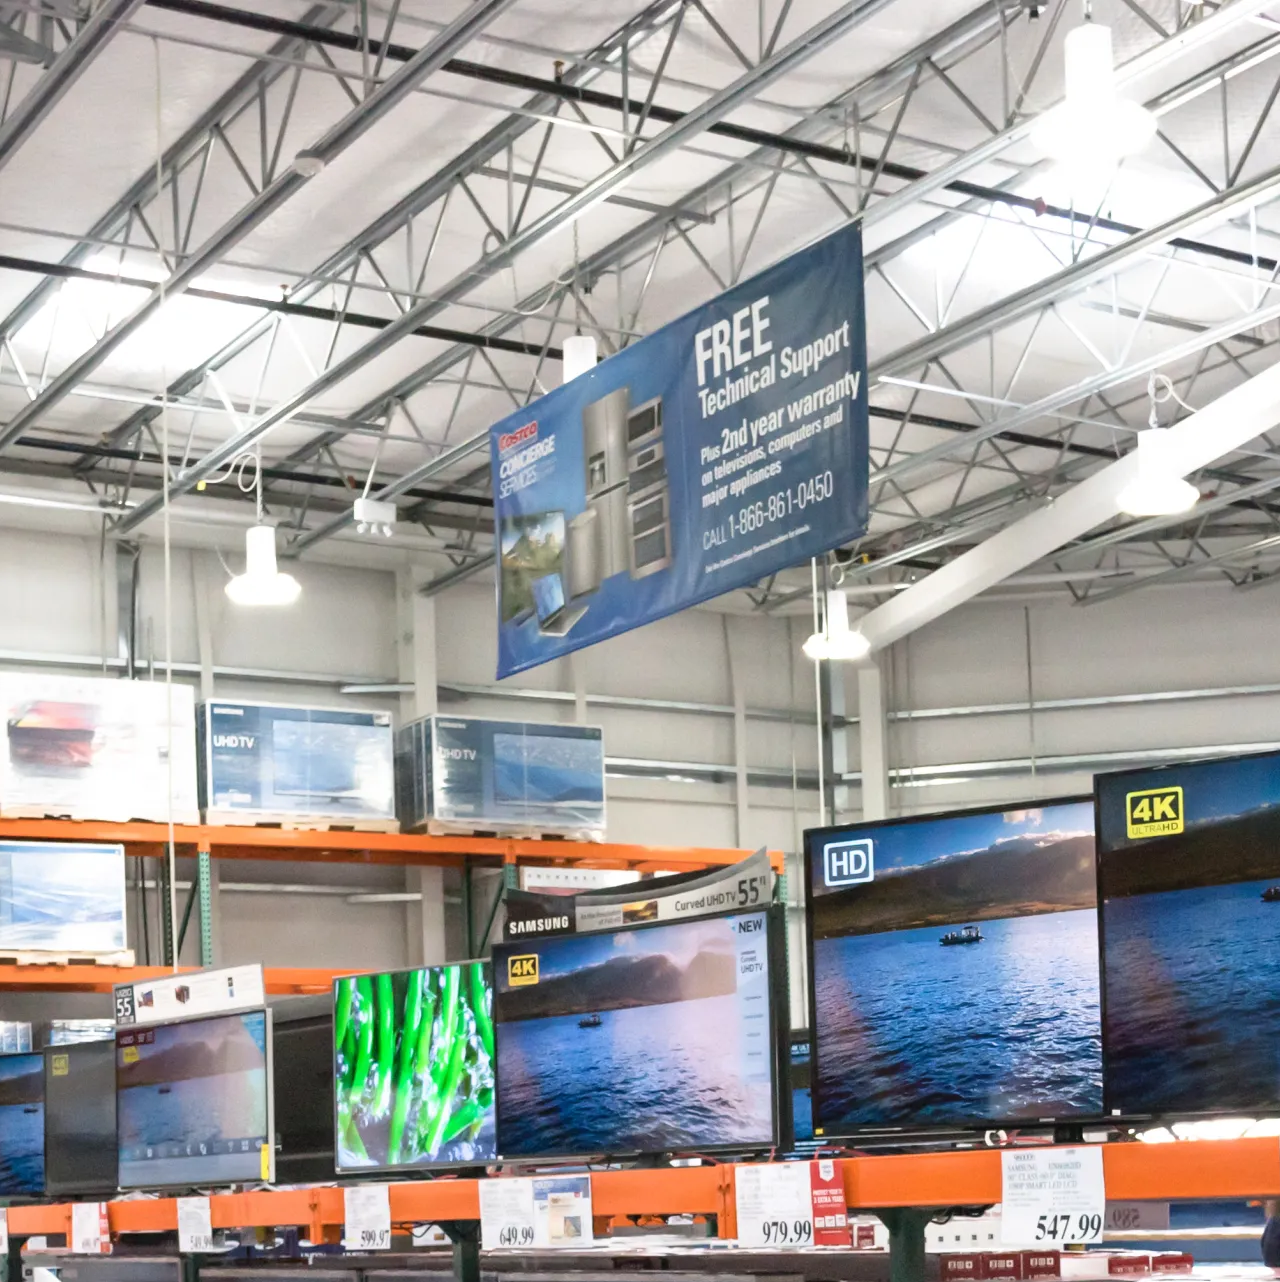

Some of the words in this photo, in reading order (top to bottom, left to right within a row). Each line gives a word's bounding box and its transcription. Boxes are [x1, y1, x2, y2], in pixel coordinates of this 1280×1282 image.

[695, 295, 773, 386] FREE
[698, 353, 776, 419] Technical
[780, 319, 850, 379] Support
[701, 444, 720, 465] Plus
[721, 418, 748, 454] 2nd
[750, 407, 785, 447] year
[787, 371, 861, 422] warranty
[702, 471, 713, 486] on
[714, 447, 767, 480] televisions,
[768, 418, 821, 454] computers
[823, 404, 843, 430] and
[702, 484, 729, 508] major
[730, 460, 782, 496] appliances
[703, 521, 728, 550] CALL
[728, 470, 833, 539] 1-866-861-0450
[1132, 794, 1177, 822] 4K
[831, 851, 867, 877] HD
[674, 898, 706, 913] Curved
[509, 915, 569, 935] SAMSUNG
[738, 918, 763, 935] NEW
[511, 959, 535, 978] 4K
[116, 998, 132, 1017] 55
[360, 1229, 390, 1248] 599.97
[499, 1226, 535, 1246] 649.99
[762, 1220, 812, 1244] 979.99
[1035, 1213, 1102, 1241] 547.99
